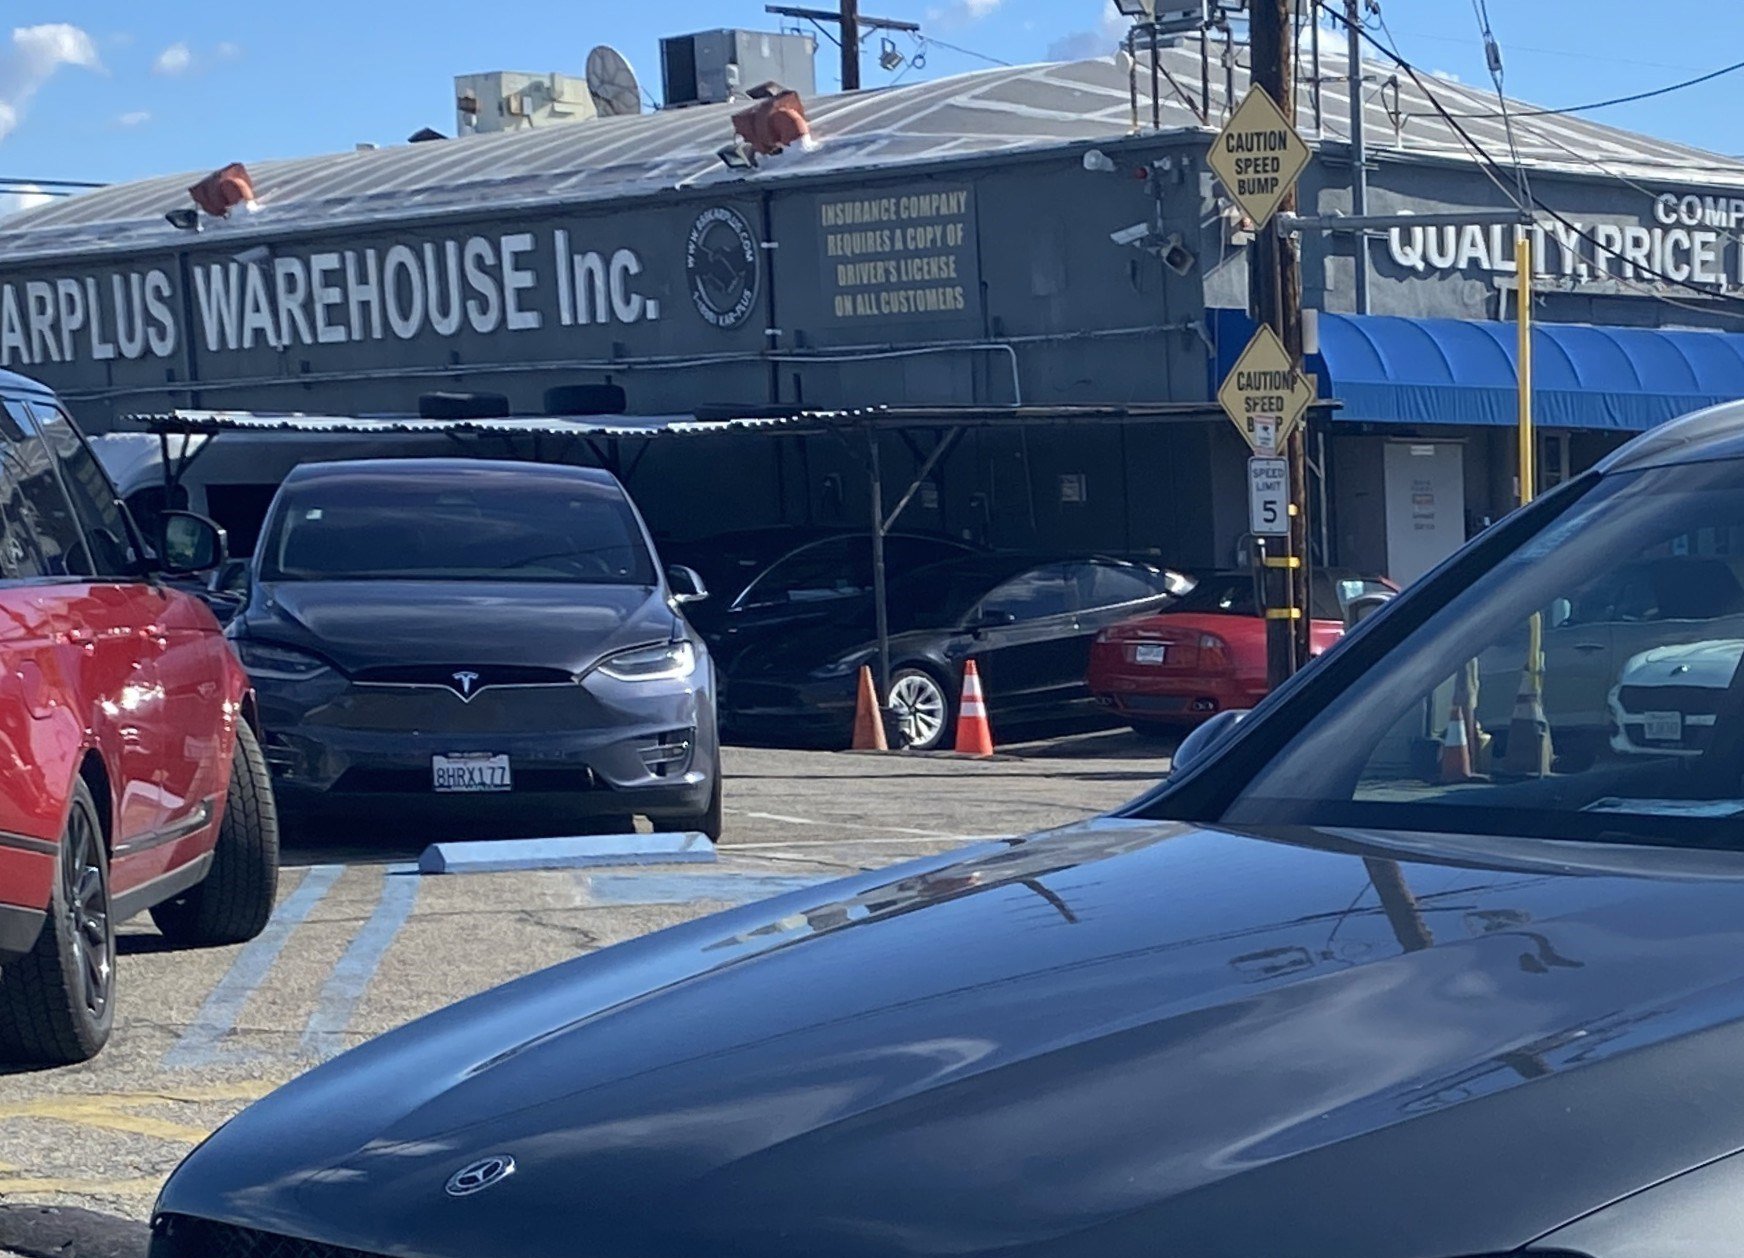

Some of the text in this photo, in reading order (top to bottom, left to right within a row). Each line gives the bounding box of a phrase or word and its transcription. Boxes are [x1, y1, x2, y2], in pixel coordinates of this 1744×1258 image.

[1226, 130, 1288, 153] CAUTION
[1235, 156, 1280, 175] SPEED
[1238, 177, 1279, 196] BUMP
[822, 191, 967, 227] INSURANCE COMPANY
[827, 223, 964, 257] REQUIRES A COPY OF
[1594, 224, 1728, 293] PRICE,
[837, 255, 957, 287] DRIVER'S LICENSE
[0, 229, 660, 366] ARPLUS WAREHOUSE Inc.
[835, 286, 965, 317] ON ALL CUSTOMERS
[1237, 371, 1293, 391] CAUTION
[1245, 396, 1284, 413] SPEED
[1247, 416, 1283, 433] BP
[1252, 467, 1285, 479] SPEED
[1256, 480, 1282, 491] LIMIT
[1263, 500, 1277, 523] 5
[436, 766, 506, 788] 8HRX177
